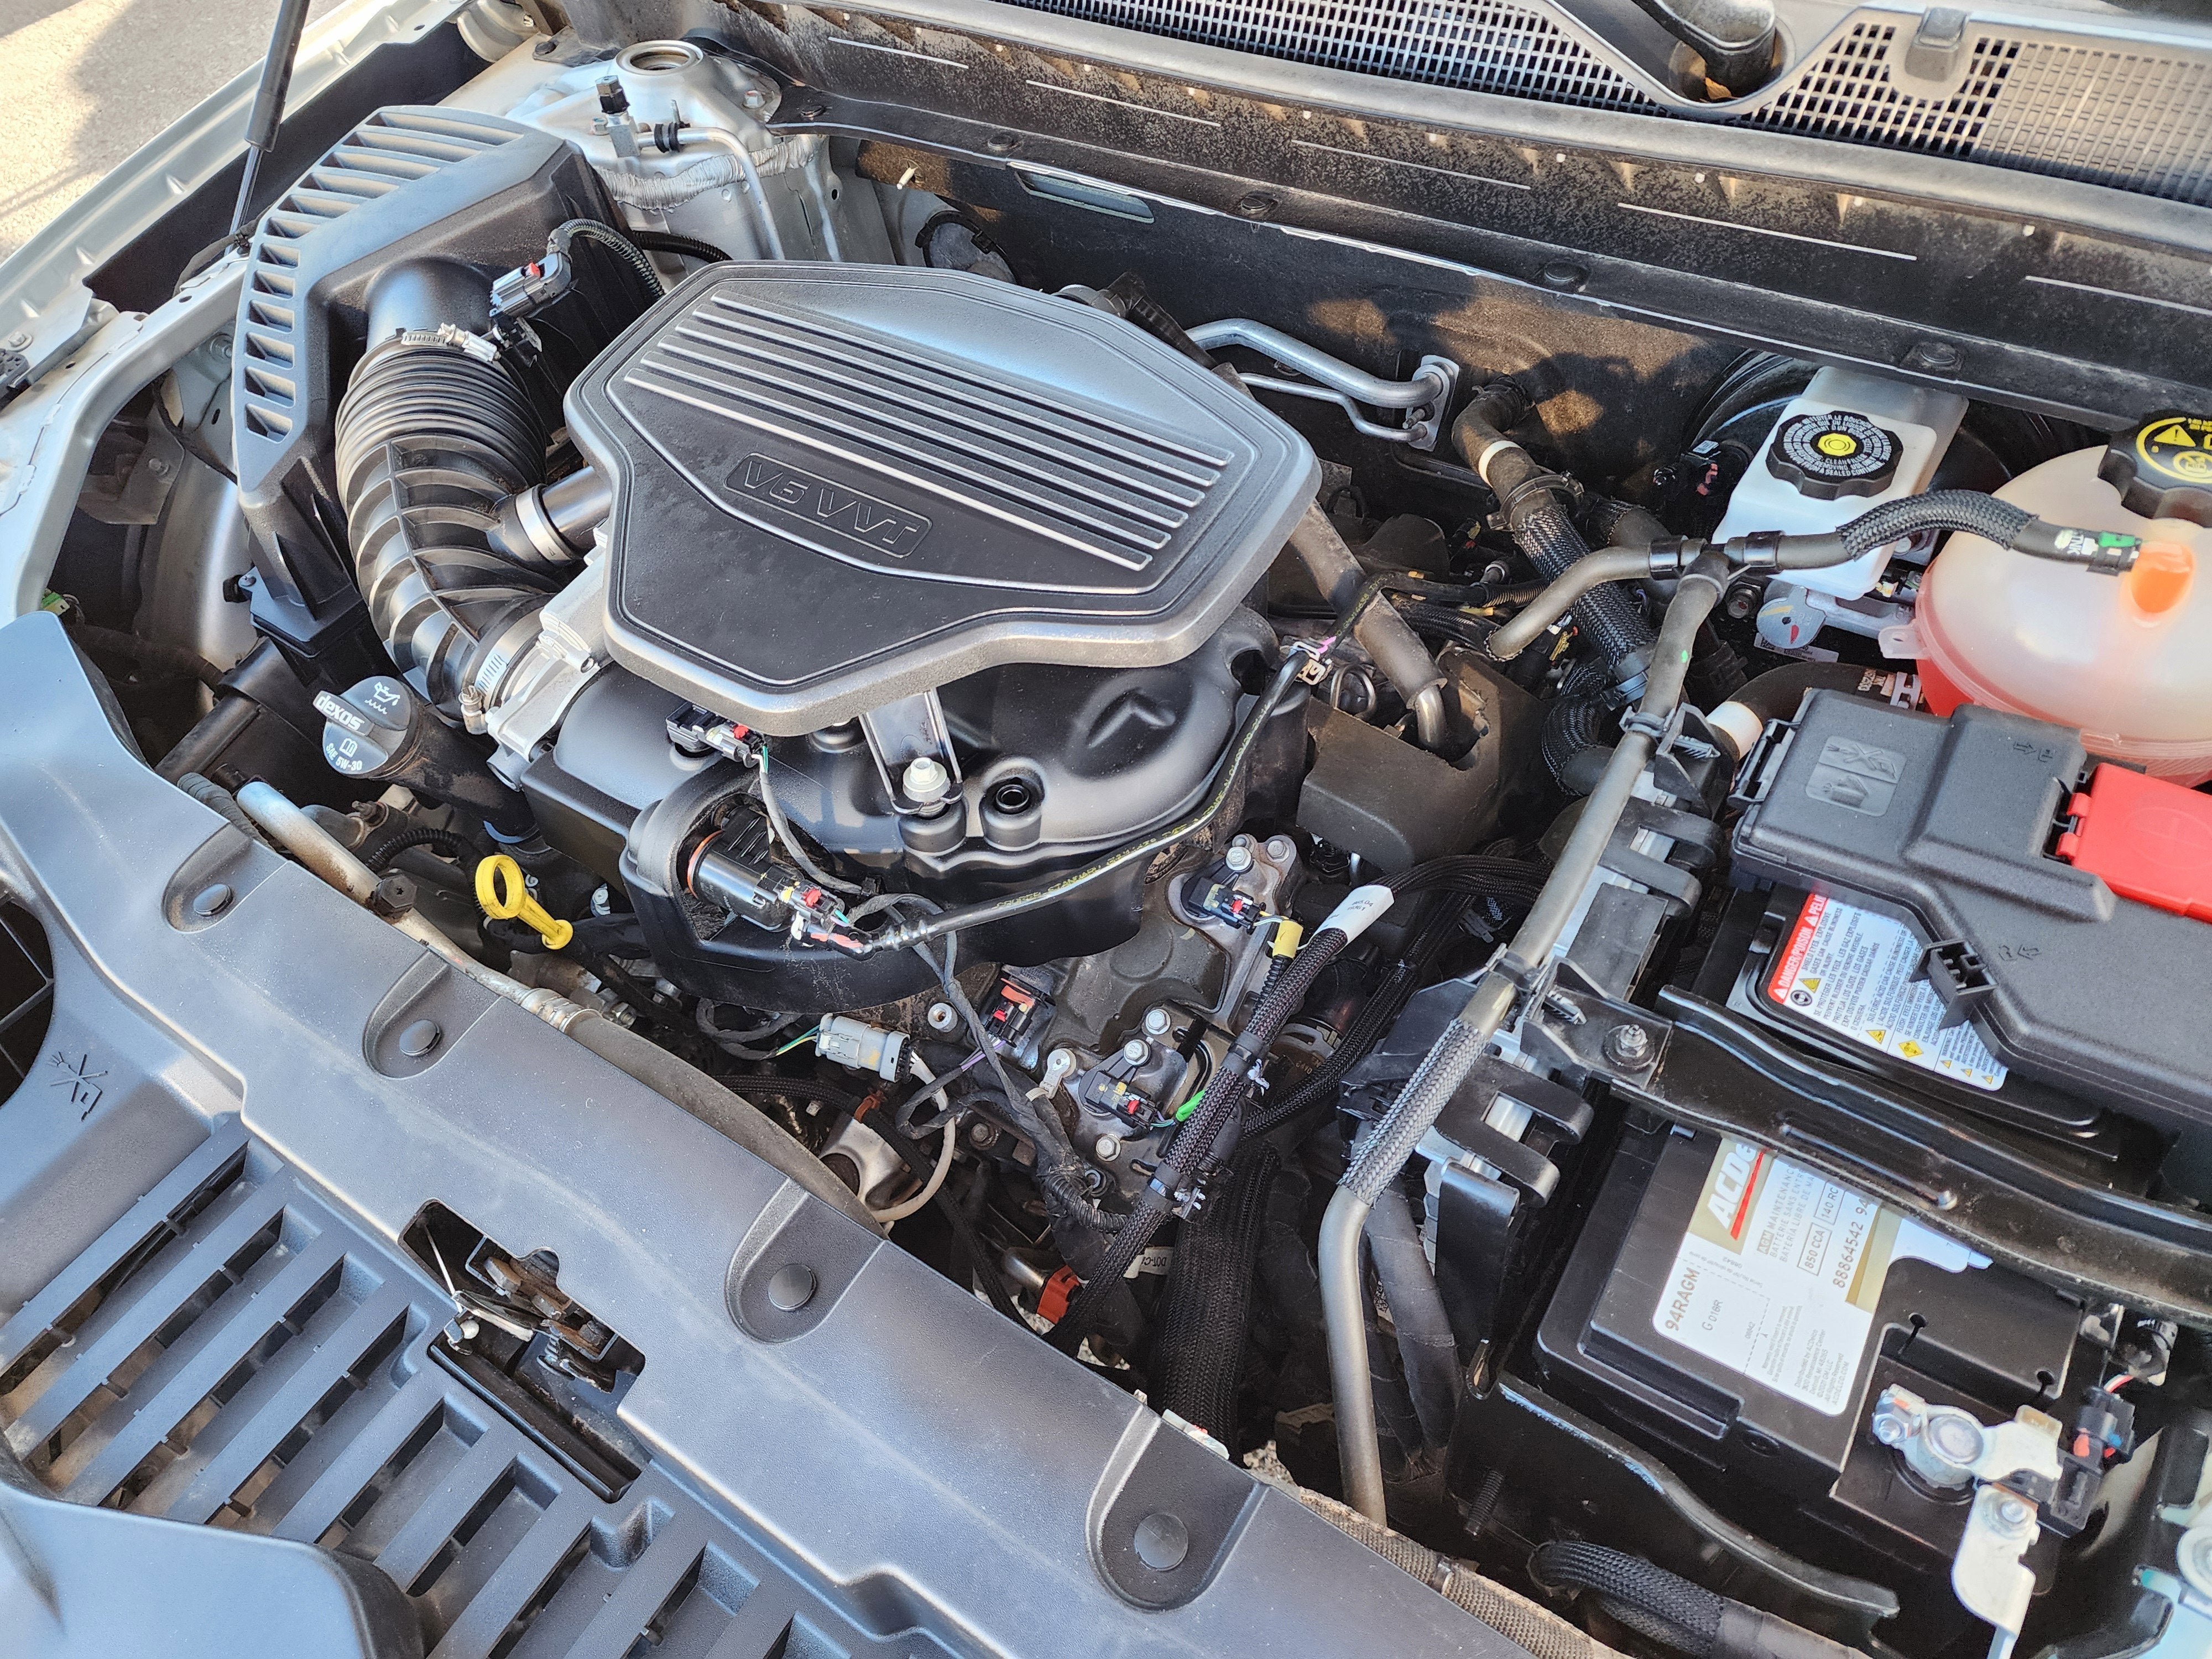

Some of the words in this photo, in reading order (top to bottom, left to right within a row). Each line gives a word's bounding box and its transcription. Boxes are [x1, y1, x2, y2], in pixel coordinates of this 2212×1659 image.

[744, 461, 810, 504] V6
[817, 488, 920, 545] VVT
[316, 694, 364, 732] dexos
[325, 743, 337, 761] SAE
[335, 755, 363, 771] 5W-30
[1845, 912, 1861, 938] EXPLOSIFS
[1801, 953, 1813, 971] SHIELD
[1815, 911, 1831, 938] EXPLOSIVE
[1810, 957, 1822, 974] GASES
[1817, 948, 1826, 957] CAN
[1822, 932, 1833, 946] CAUSE
[1828, 907, 1843, 931] BLINDNESS
[1837, 948, 1846, 958] LES
[1841, 937, 1851, 948] GAZ
[1891, 936, 1905, 961] BLINDNESS
[1778, 927, 1813, 988] DANGER/POISON
[1856, 946, 1868, 963] GASES
[1827, 973, 1837, 983] LES
[1852, 963, 1861, 973] LOS
[1881, 975, 1890, 985] CAN
[1885, 960, 1896, 975] CAUSE
[1841, 995, 1859, 1027] EXPLOSIVOS
[1854, 976, 1866, 995] PUEDEN
[1861, 958, 1872, 977] CAUSAR
[1869, 942, 1880, 958] DAÑOS
[1842, 989, 1851, 1000] LOS
[1876, 985, 1886, 998] ACID
[1917, 991, 1925, 1003] YEUX
[1823, 999, 1835, 1019] PEUVENT
[1832, 1001, 1846, 1023] PROTEJA
[1867, 997, 1881, 1022] SULFURIC
[1876, 1005, 1889, 1026] L'ACIDE
[1884, 975, 1901, 1006] SULFURIQUE
[1913, 1003, 1922, 1012] LES
[1896, 1018, 1906, 1032] FLUSH
[1902, 1004, 1911, 1016] EYES
[1907, 1011, 1918, 1029] RINSER
[1913, 1012, 1927, 1039] CONSULTER
[1922, 1020, 1935, 1043] ENJUAGE
[1759, 1232, 1775, 1253] AGM
[1767, 1164, 1797, 1229] MAINTENANC
[1792, 1202, 1807, 1226] LIBRE
[1801, 1189, 1811, 1201] DE
[1822, 1202, 1834, 1218] 140
[1828, 1187, 1838, 1201] RC
[1767, 1218, 1789, 1258] BATTERIE
[1783, 1196, 1797, 1217] SANS
[1804, 1250, 1818, 1269] 850
[1811, 1230, 1825, 1248] CCA
[1833, 1222, 1864, 1288] 88864542
[1665, 1267, 1700, 1331] 94RAGM
[1702, 1322, 1713, 1331] G
[1708, 1300, 1723, 1322] 016R
[1806, 1329, 1818, 1352] ACDelco
[1815, 1329, 1825, 1347] Center
[1831, 1353, 1844, 1377] Reserved
